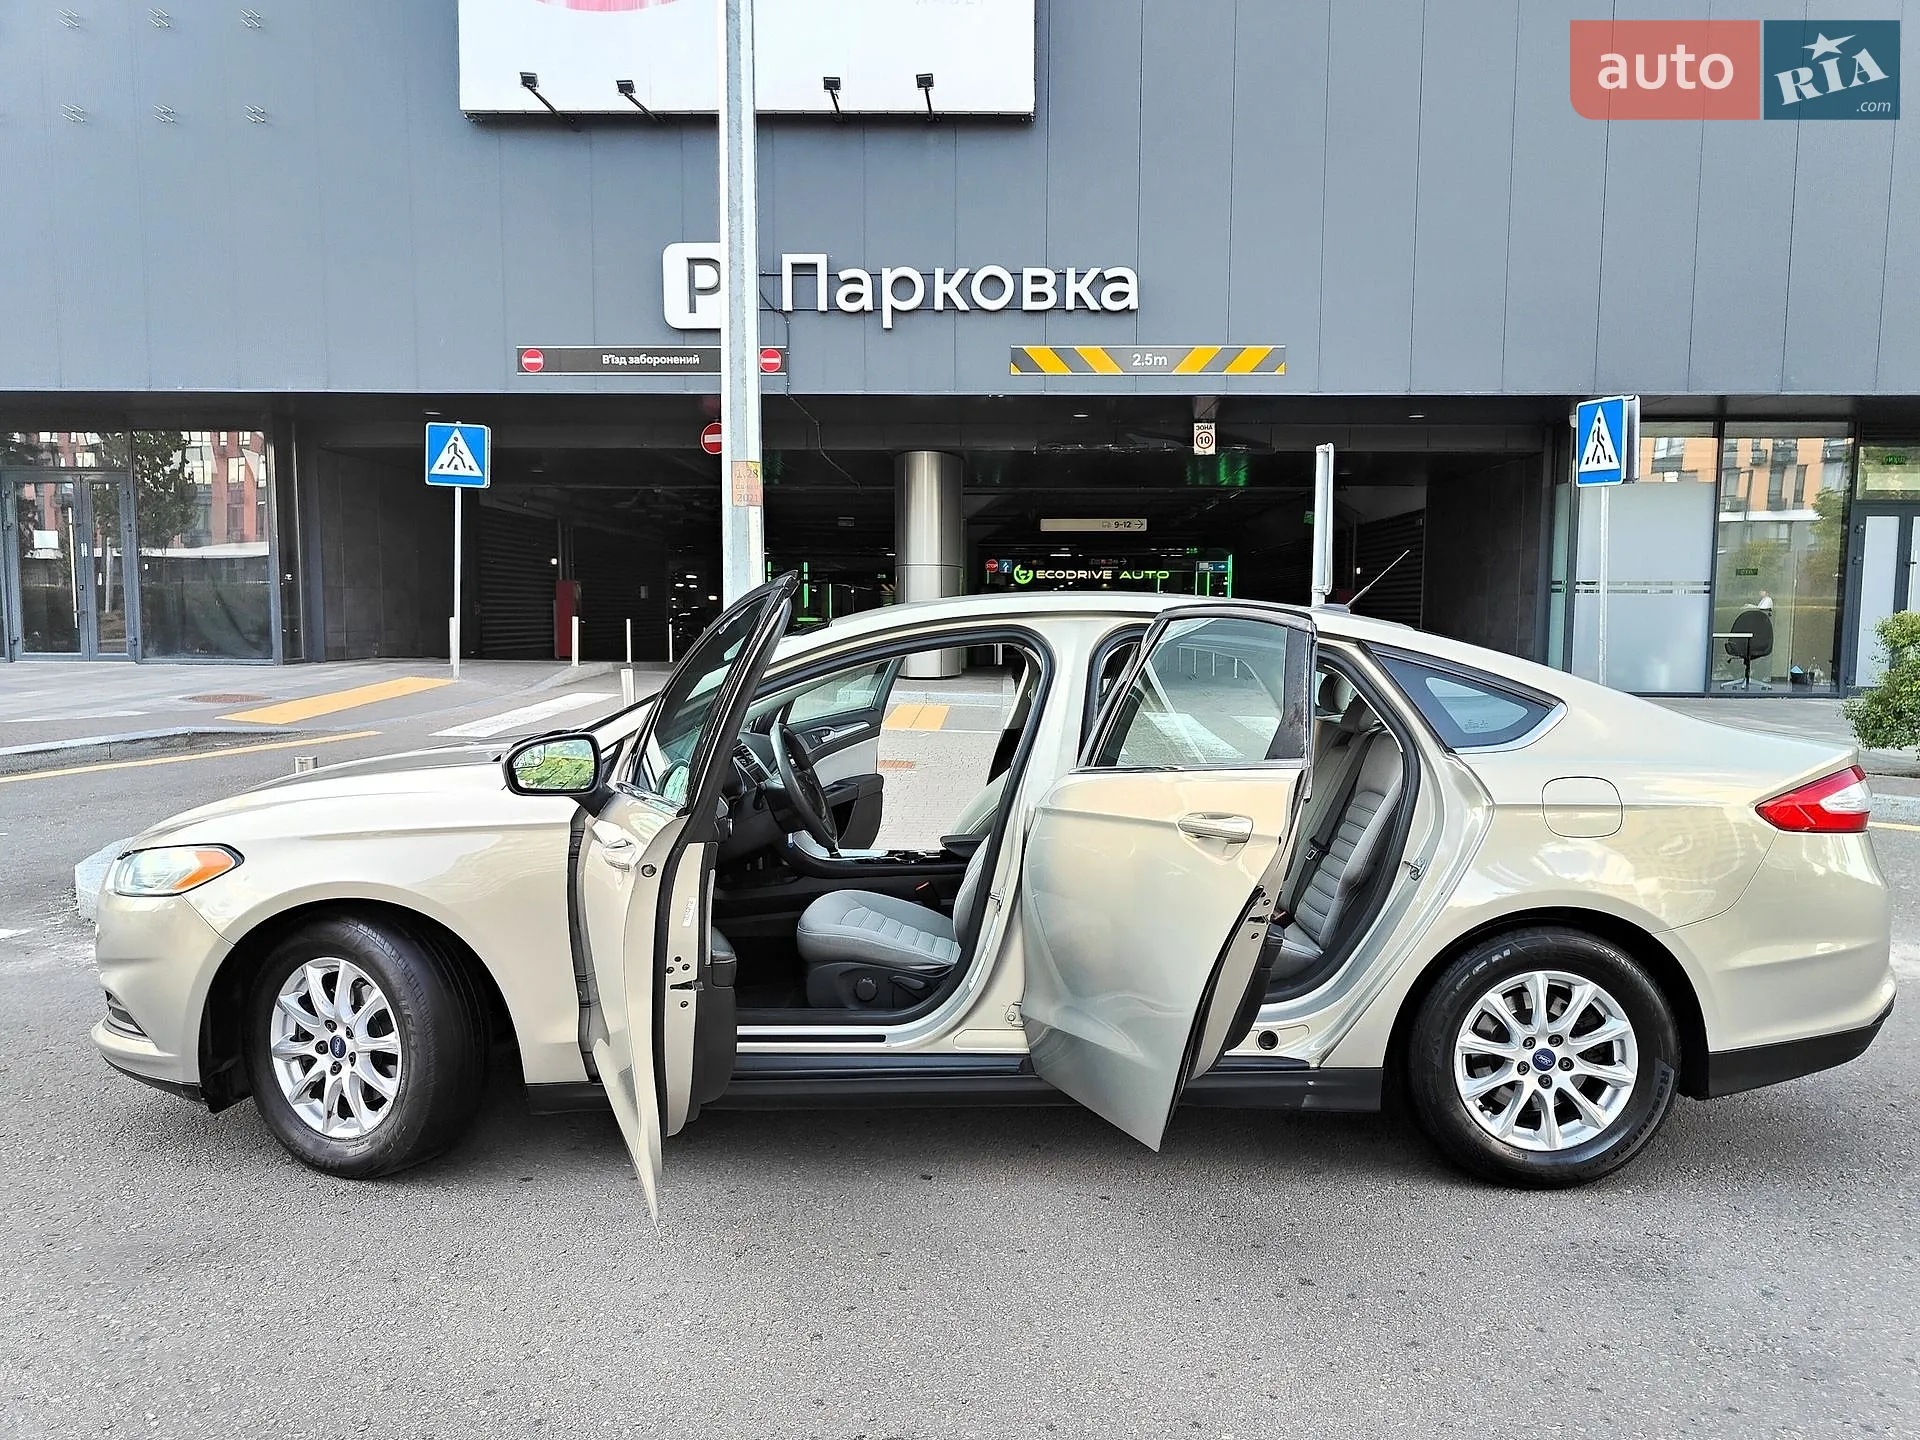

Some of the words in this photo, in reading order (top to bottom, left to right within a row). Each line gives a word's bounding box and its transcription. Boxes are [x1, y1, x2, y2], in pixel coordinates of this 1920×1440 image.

[781, 253, 1139, 329] Парковка
[628, 353, 700, 366] заборонений
[1199, 435, 1211, 445] 10
[1114, 520, 1132, 529] 9-12
[1035, 570, 1112, 580] ECODRIVE
[1119, 570, 1169, 580] AUTO
